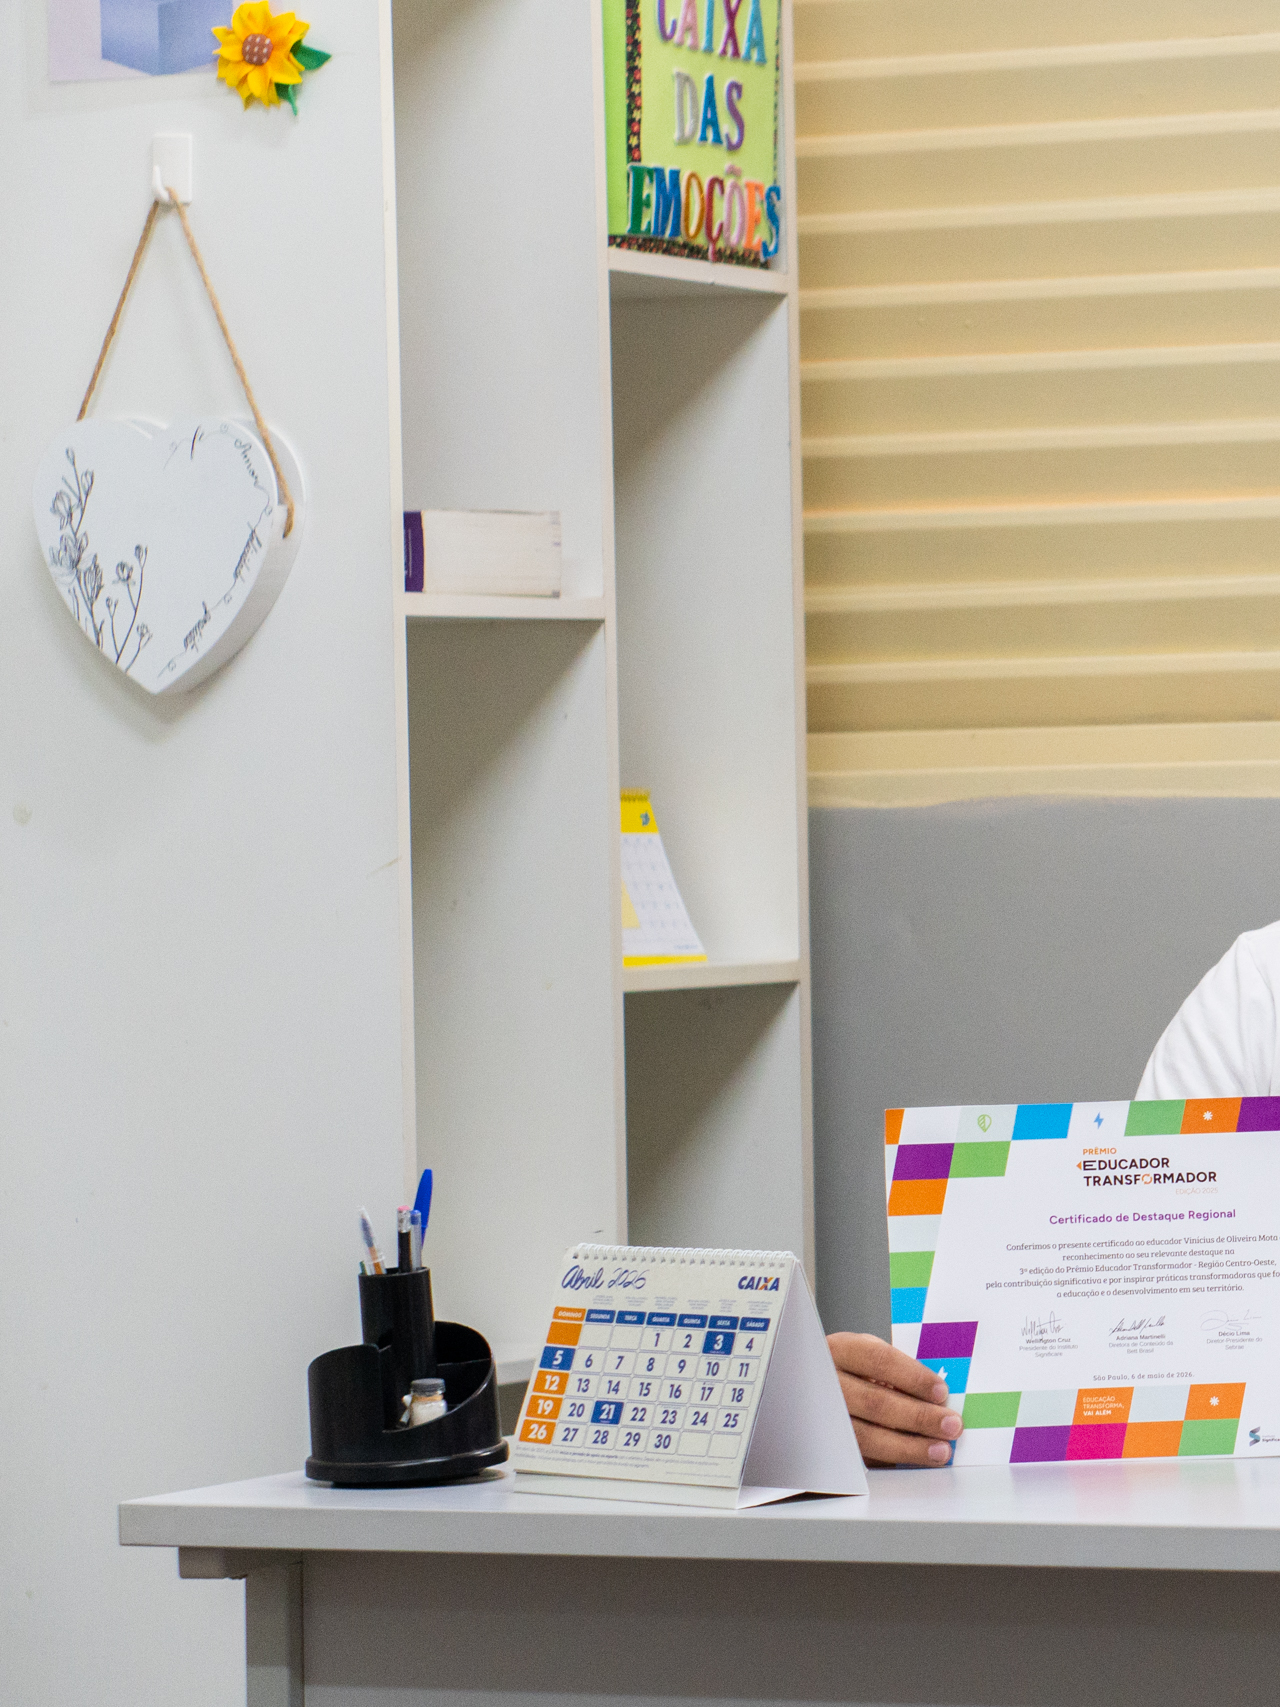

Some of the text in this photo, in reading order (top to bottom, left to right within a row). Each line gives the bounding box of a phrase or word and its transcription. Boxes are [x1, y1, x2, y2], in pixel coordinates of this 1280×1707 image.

[657, 0, 767, 65] CAIXA
[674, 68, 745, 151] DAS
[627, 162, 781, 262] EMOÇÕES
[1083, 1147, 1117, 1155] PRÊMIO
[1083, 1158, 1170, 1171] EDUCADOR
[1084, 1171, 1217, 1187] TRANSFORMADOR
[1176, 1187, 1201, 1195] EDIÇÃO
[1050, 1209, 1235, 1224] Certificado de Destaque Regional
[1006, 1243, 1051, 1251] Conferimos
[1058, 1242, 1091, 1250] presente
[1184, 1236, 1214, 1244] Vinícius
[1063, 1253, 1124, 1261] reconhecimento
[1189, 1249, 1223, 1257] destaque
[1029, 1267, 1054, 1276] edição
[1066, 1265, 1094, 1273] Prêmio
[1095, 1264, 1131, 1272] Educador
[1133, 1262, 1192, 1270] Transformador
[1199, 1261, 1224, 1269] Região
[1225, 1259, 1276, 1267] Centro-Oeste,
[561, 1265, 650, 1290] Abril 2026
[737, 1275, 780, 1291] CAIXA
[986, 1281, 1002, 1290] pela
[1003, 1279, 1052, 1288] contribuição
[1054, 1277, 1101, 1287] significativa
[1124, 1276, 1154, 1284] inspirar
[1156, 1274, 1188, 1283] práticas
[1190, 1272, 1256, 1280] transformadoras
[1063, 1290, 1099, 1298] educação
[1207, 1284, 1244, 1292] território.
[746, 1320, 765, 1328] SÁBADO
[654, 1333, 754, 1352] 1 2 3 4
[553, 1351, 749, 1377] 5 6 7 8 9 10 11
[545, 1375, 744, 1402] 12 13 14 15 16 17 18
[538, 1399, 739, 1428] 19 20 21 22 23 24 25
[529, 1424, 671, 1449] 26 27 28 29 30
